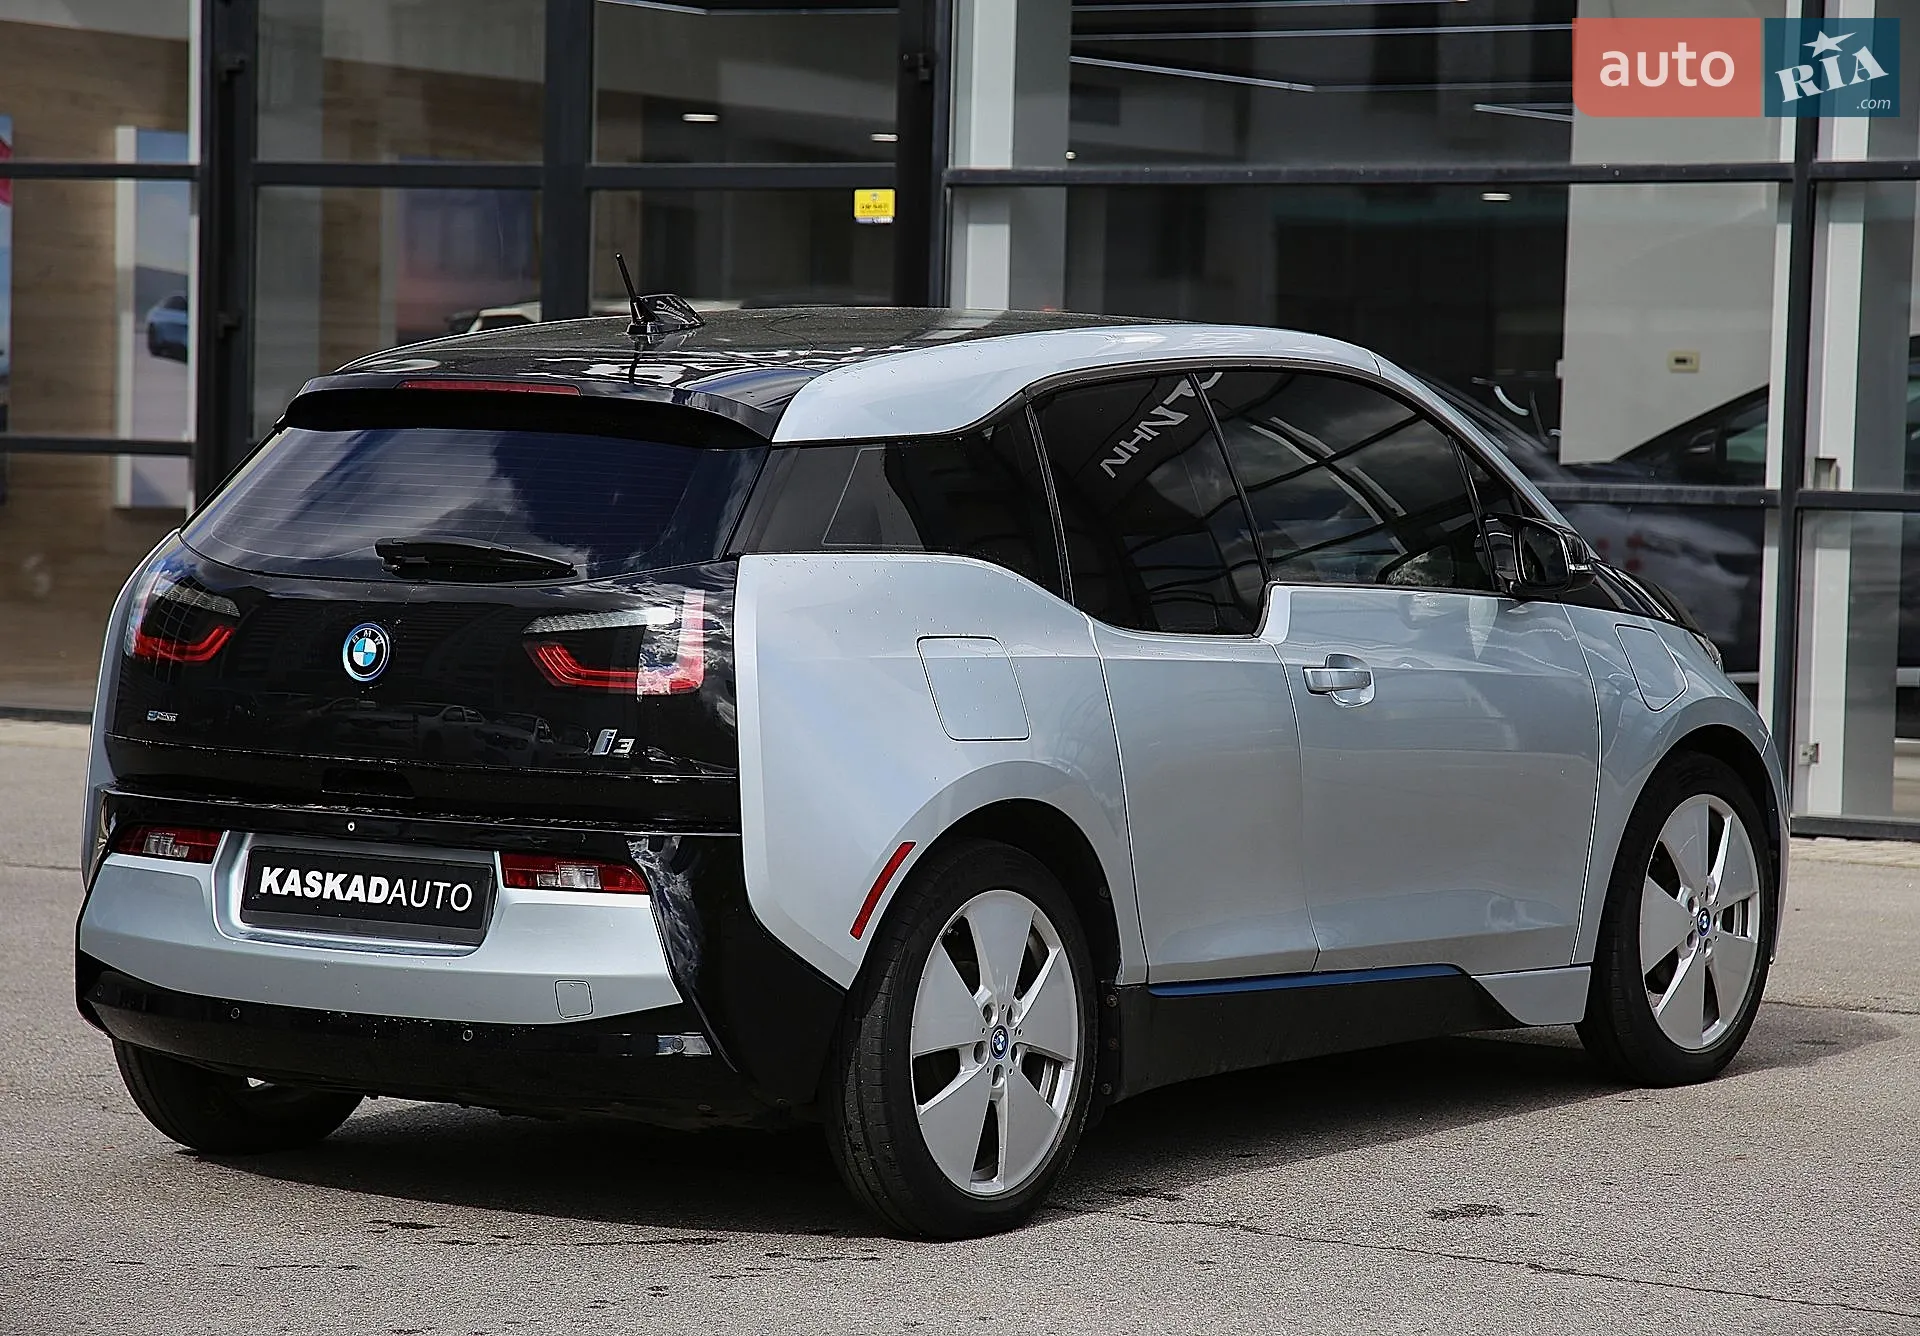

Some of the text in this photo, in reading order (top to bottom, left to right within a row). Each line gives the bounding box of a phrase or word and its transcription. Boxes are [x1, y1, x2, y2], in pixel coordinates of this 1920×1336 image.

[352, 629, 384, 645] BMW
[592, 728, 635, 755] i3
[259, 866, 473, 912] KASKADAUTO
